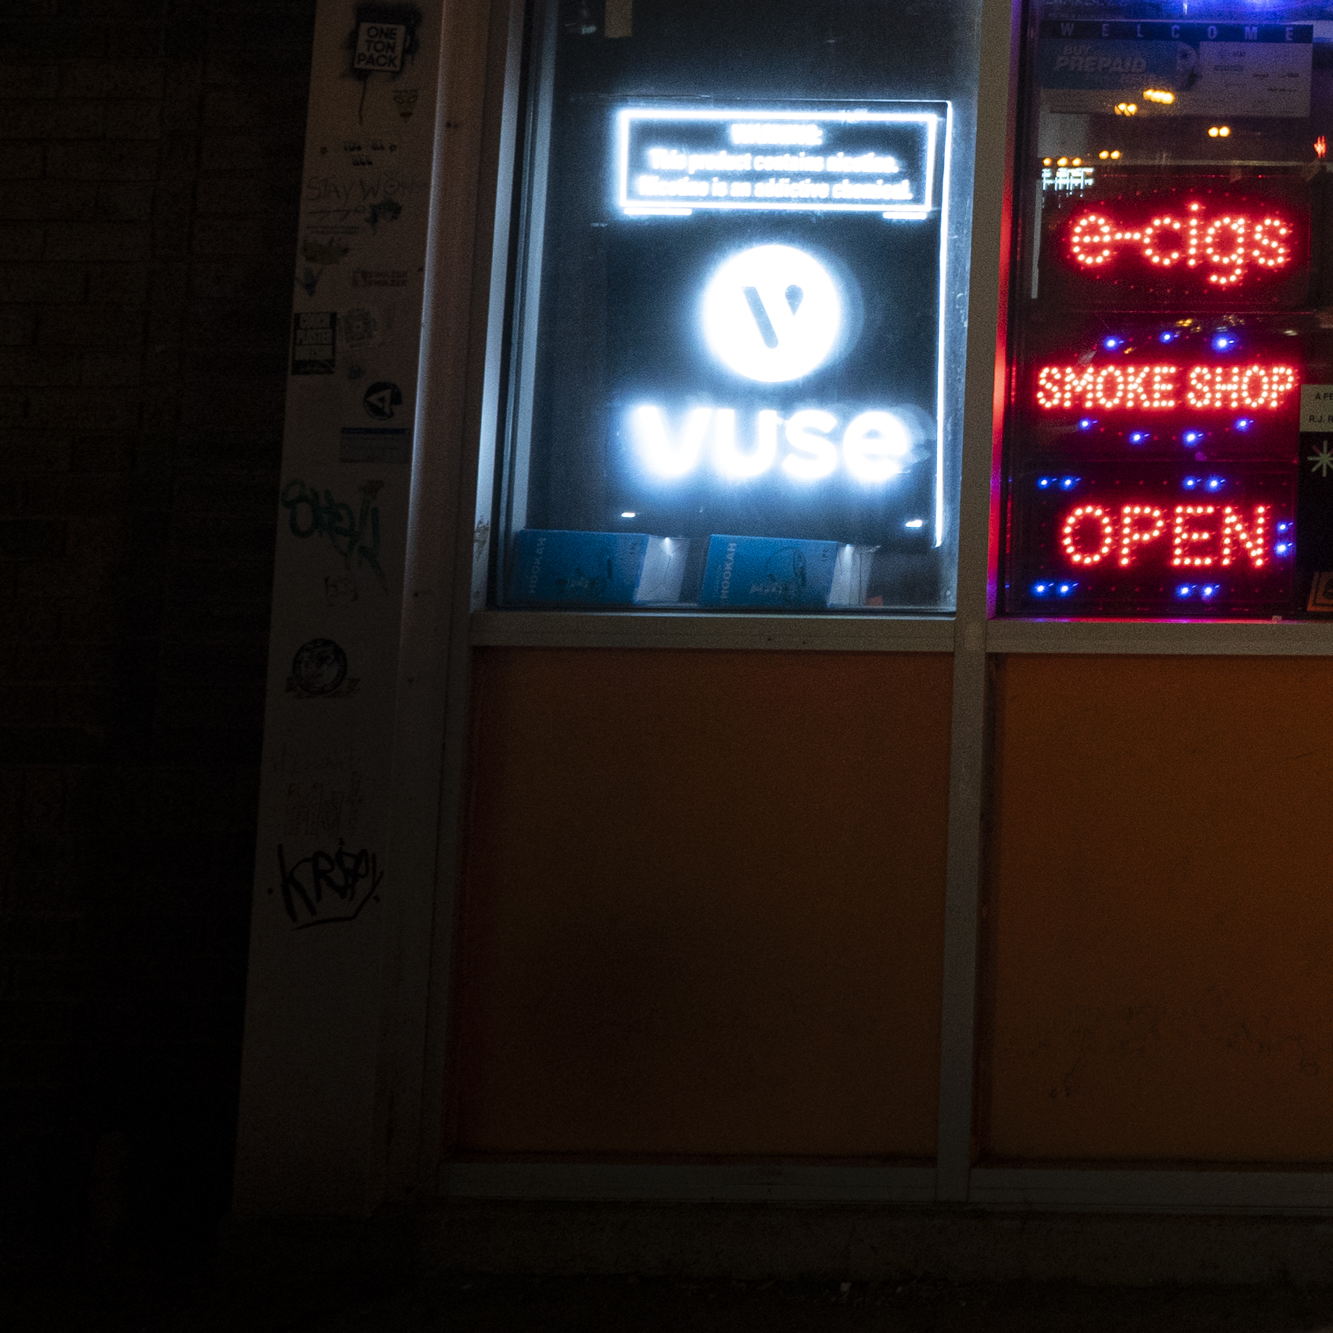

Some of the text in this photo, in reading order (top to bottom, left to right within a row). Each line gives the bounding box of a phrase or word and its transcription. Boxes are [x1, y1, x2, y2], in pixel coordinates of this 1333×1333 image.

[366, 26, 398, 41] ONE
[1060, 24, 1295, 42] WELCOME
[366, 40, 397, 54] TON
[356, 52, 398, 68] PACK
[1070, 201, 1290, 285] e-cigs
[1035, 365, 1297, 408] SMOKE SHOP
[1315, 392, 1322, 401] A
[1309, 415, 1325, 423] R.J.
[1060, 503, 1268, 567] OPEN
[718, 542, 738, 603] HOOKAH
